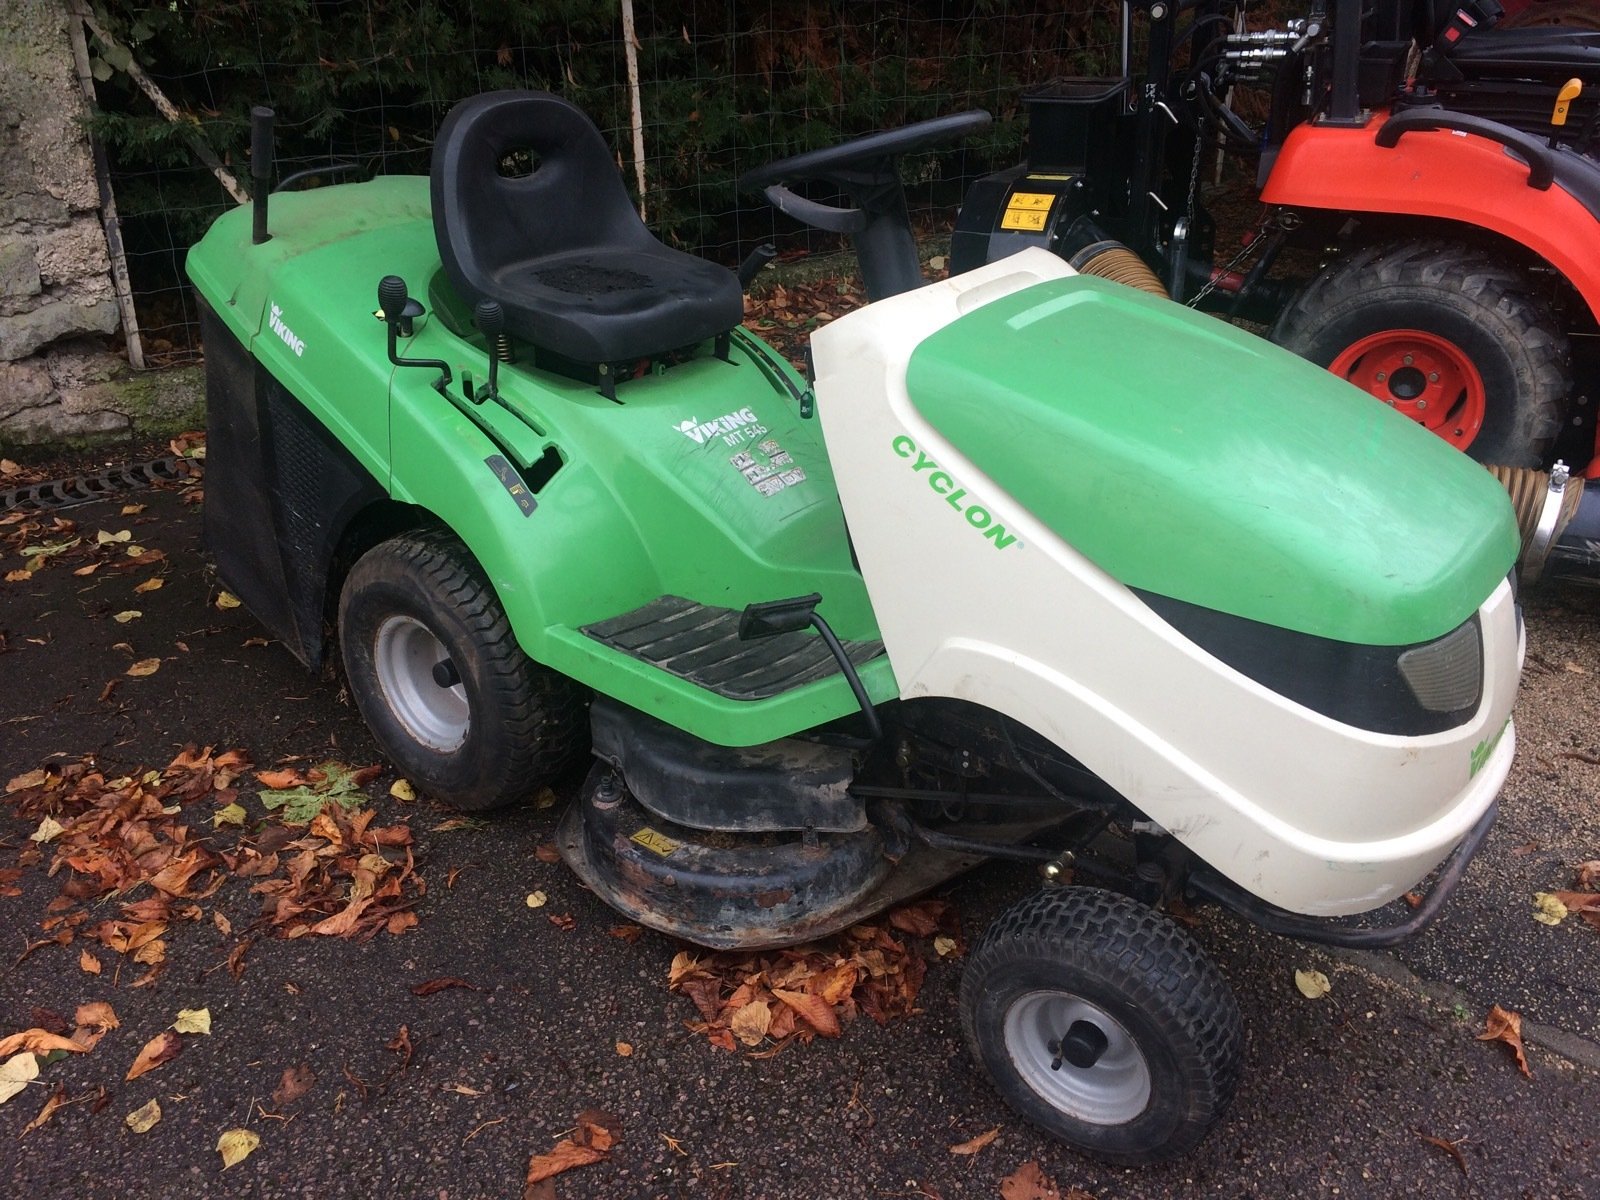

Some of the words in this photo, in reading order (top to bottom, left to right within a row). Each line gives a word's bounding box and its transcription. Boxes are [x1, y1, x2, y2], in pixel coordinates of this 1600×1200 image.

[269, 312, 305, 358] VIKING
[683, 407, 758, 444] VIKING
[722, 430, 745, 447] MT
